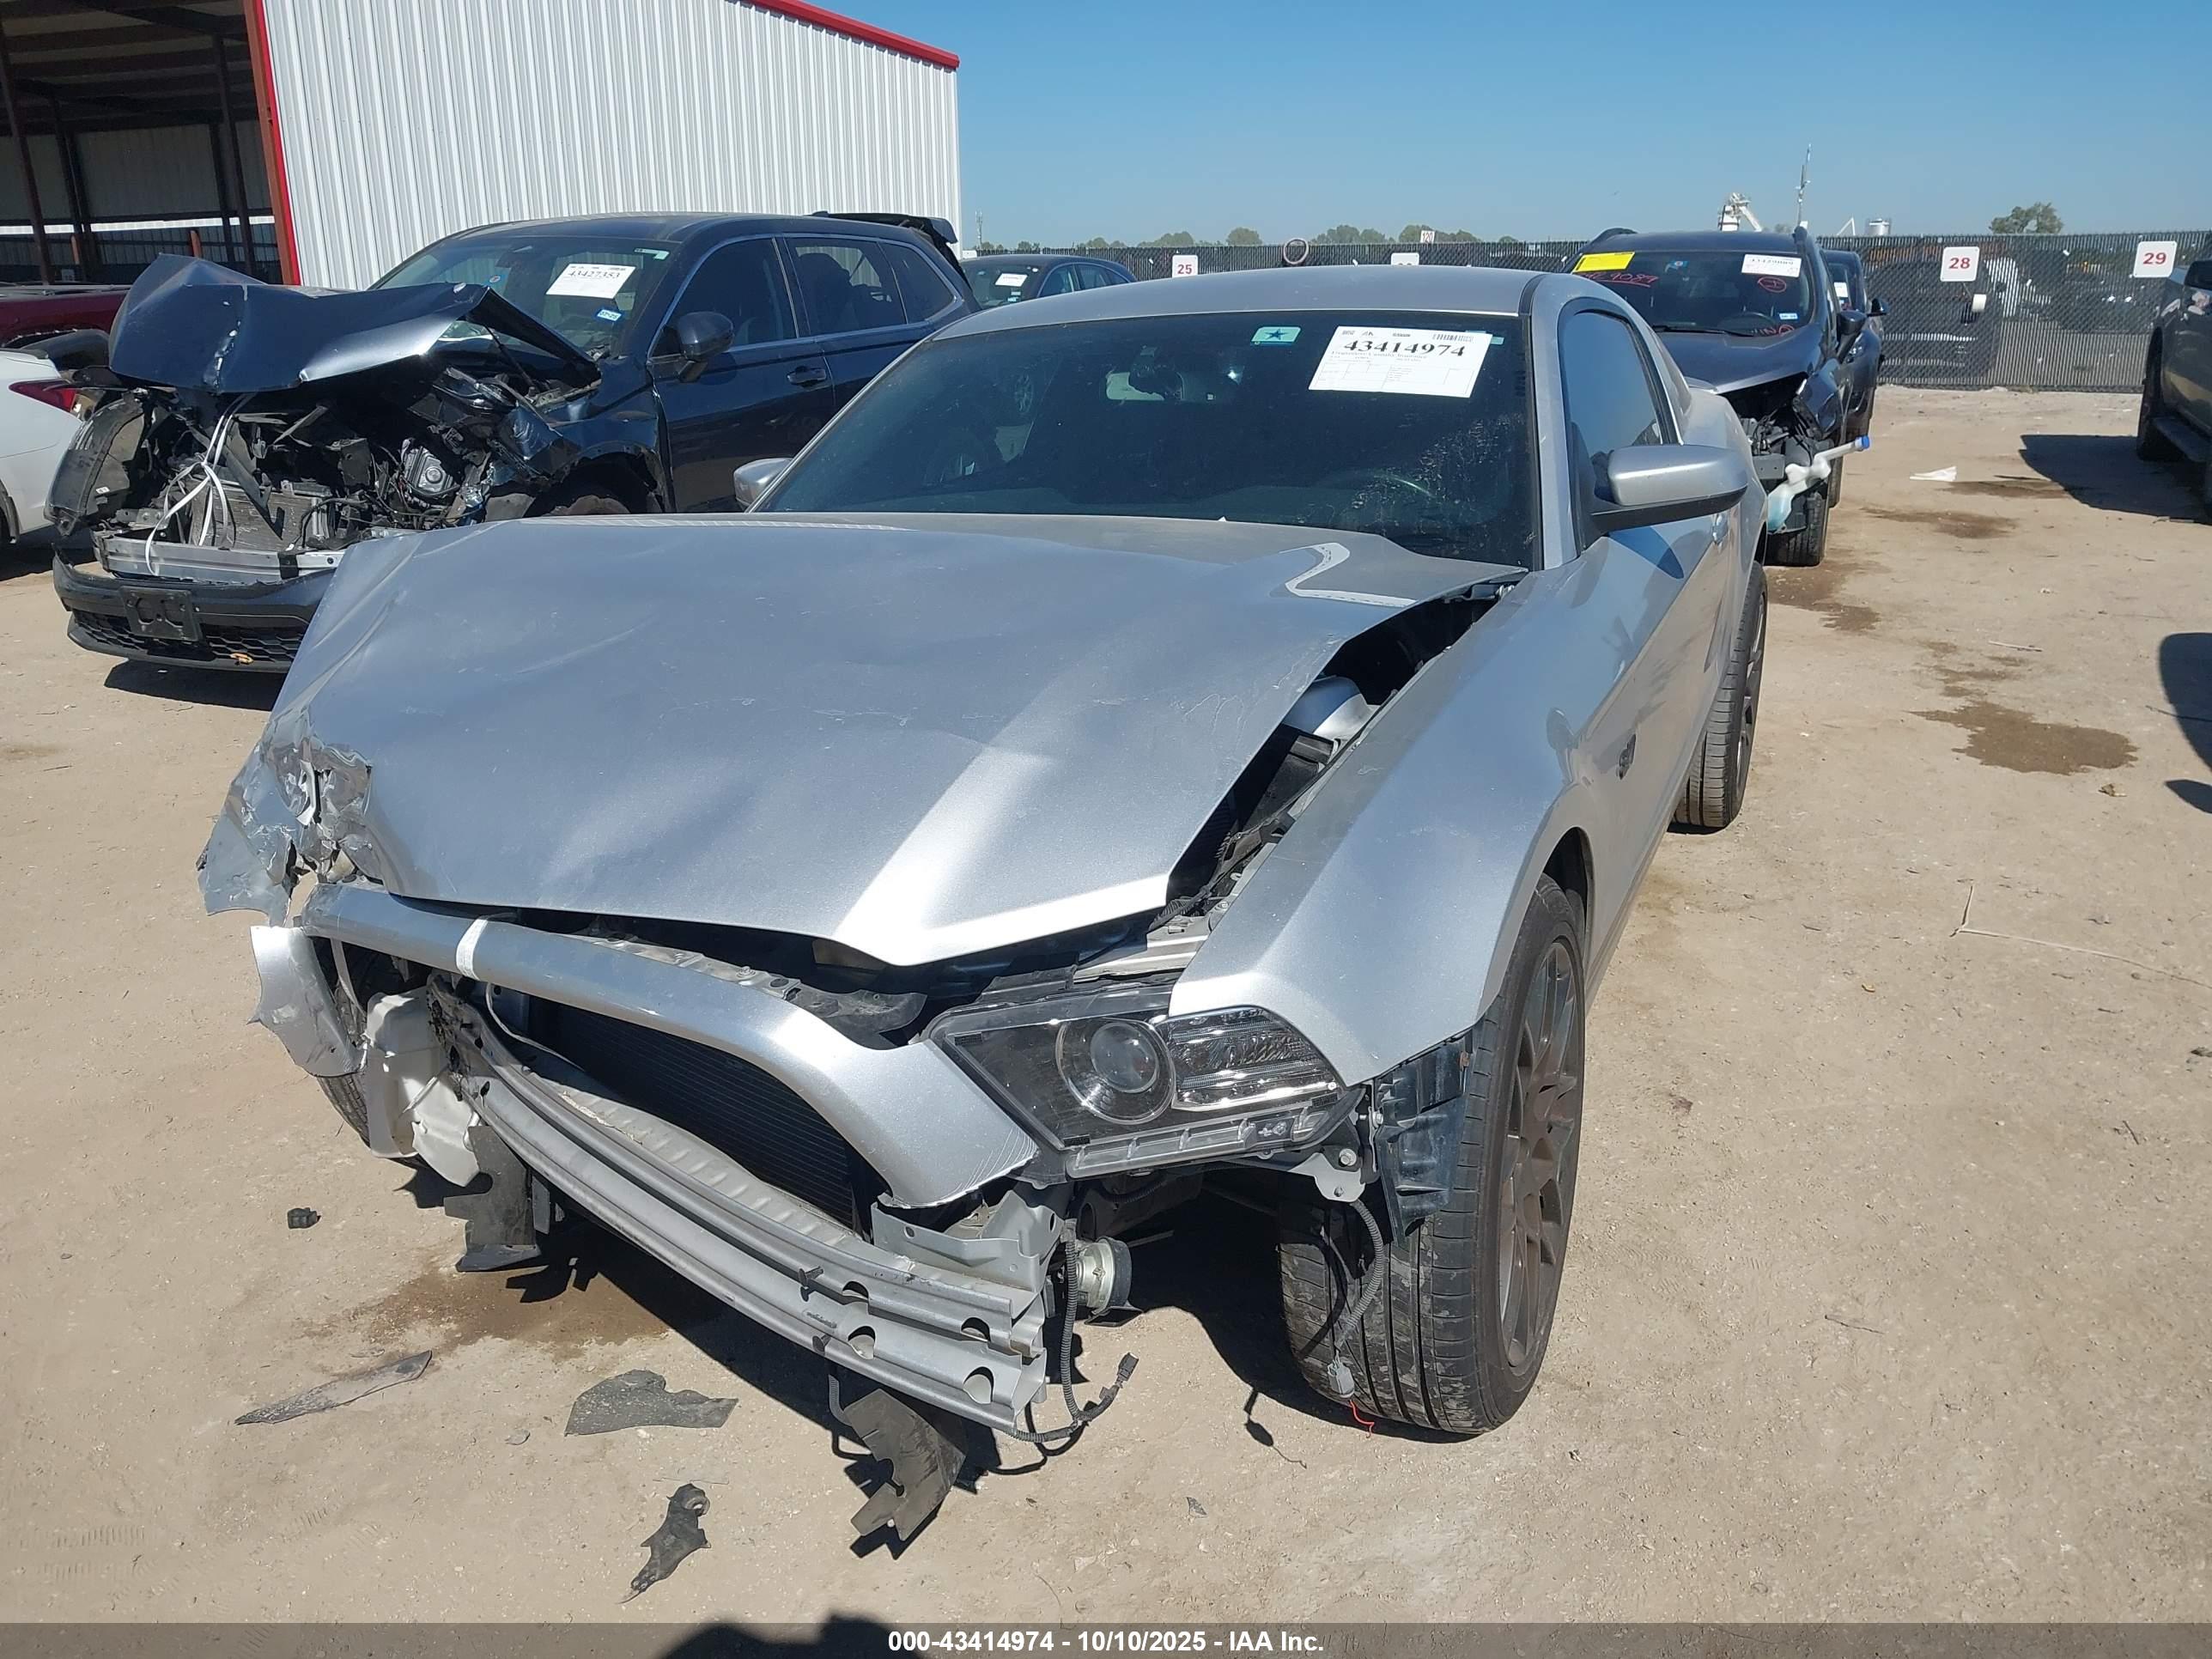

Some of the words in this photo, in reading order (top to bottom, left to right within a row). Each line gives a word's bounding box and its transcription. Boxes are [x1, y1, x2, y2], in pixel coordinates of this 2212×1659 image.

[1949, 257, 1971, 270] 28
[2142, 252, 2166, 264] 29
[1177, 264, 1193, 275] 25
[1344, 340, 1466, 356] 43414974
